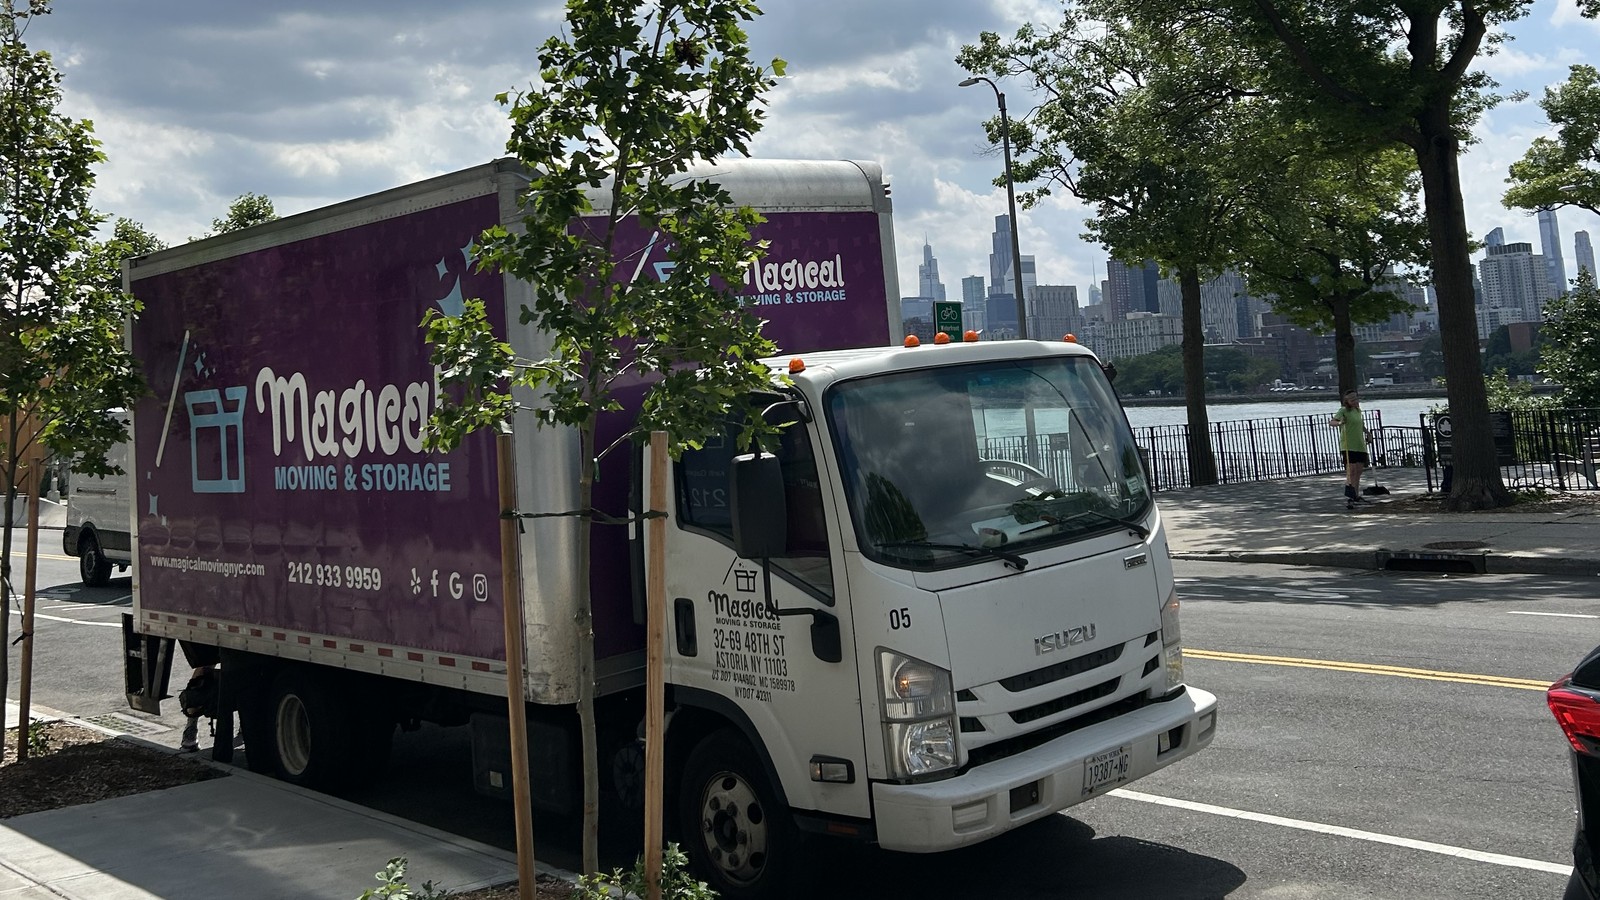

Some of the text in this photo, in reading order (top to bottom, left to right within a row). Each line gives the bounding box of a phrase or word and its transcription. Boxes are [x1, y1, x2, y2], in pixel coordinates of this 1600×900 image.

[785, 293, 793, 304] &
[796, 290, 846, 304] STORAGE
[275, 462, 451, 491] MOVING & STORAGE
[150, 555, 265, 577] www.magicalmovingnyc.com
[288, 562, 313, 584] 212
[316, 564, 341, 587] 933
[345, 566, 382, 591] 9959
[716, 617, 740, 626] MOVING
[749, 620, 781, 630] STORAGE
[889, 607, 911, 630] 05
[713, 628, 785, 656] 32-69 48TH ST
[1034, 623, 1096, 656] ISUZU
[716, 651, 787, 677] ASTORIA NY 11103
[720, 670, 731, 682] DOT
[759, 676, 768, 688] MC
